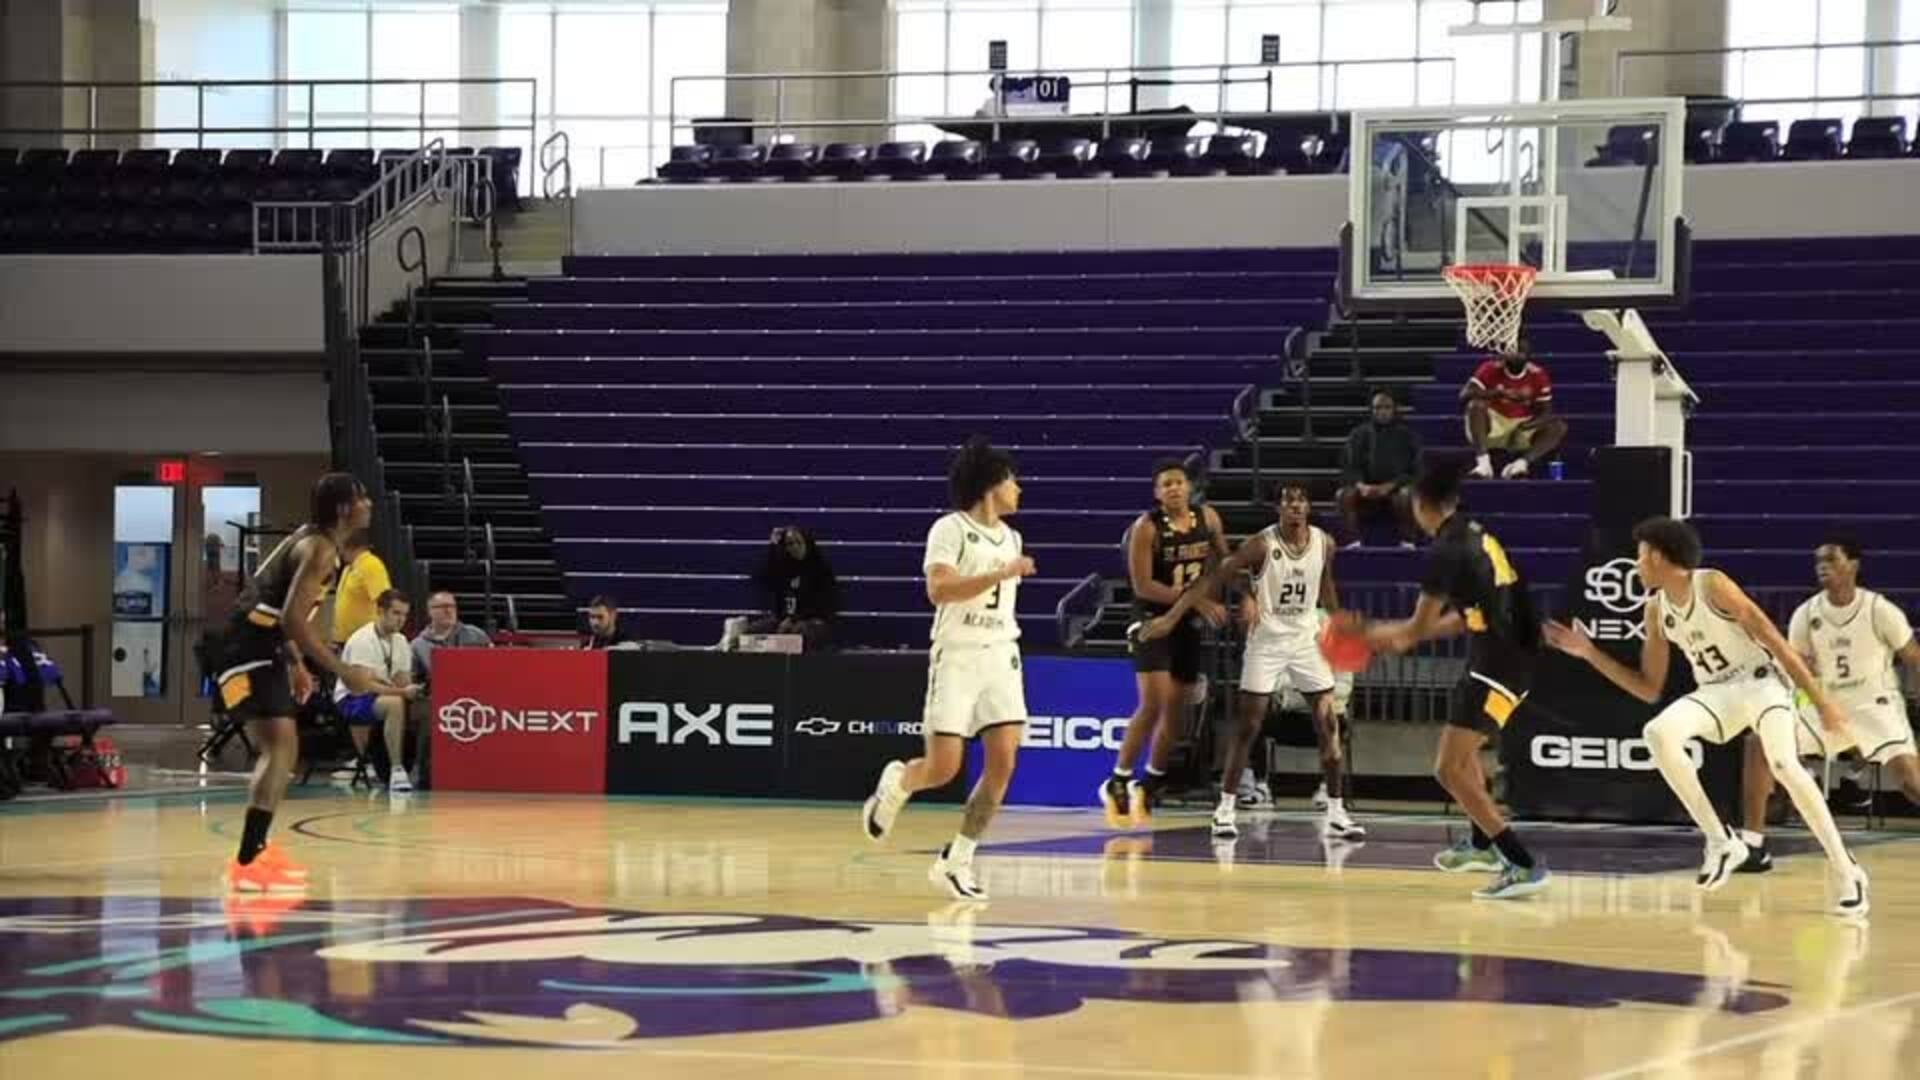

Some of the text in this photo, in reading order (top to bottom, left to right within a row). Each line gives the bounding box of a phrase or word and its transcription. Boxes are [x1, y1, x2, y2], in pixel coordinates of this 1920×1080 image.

[1032, 80, 1058, 97] 101
[985, 582, 1001, 610] 3
[1279, 583, 1306, 604] 24
[1836, 655, 1850, 678] 5
[501, 710, 599, 732] NEXT
[618, 701, 774, 745] AXE
